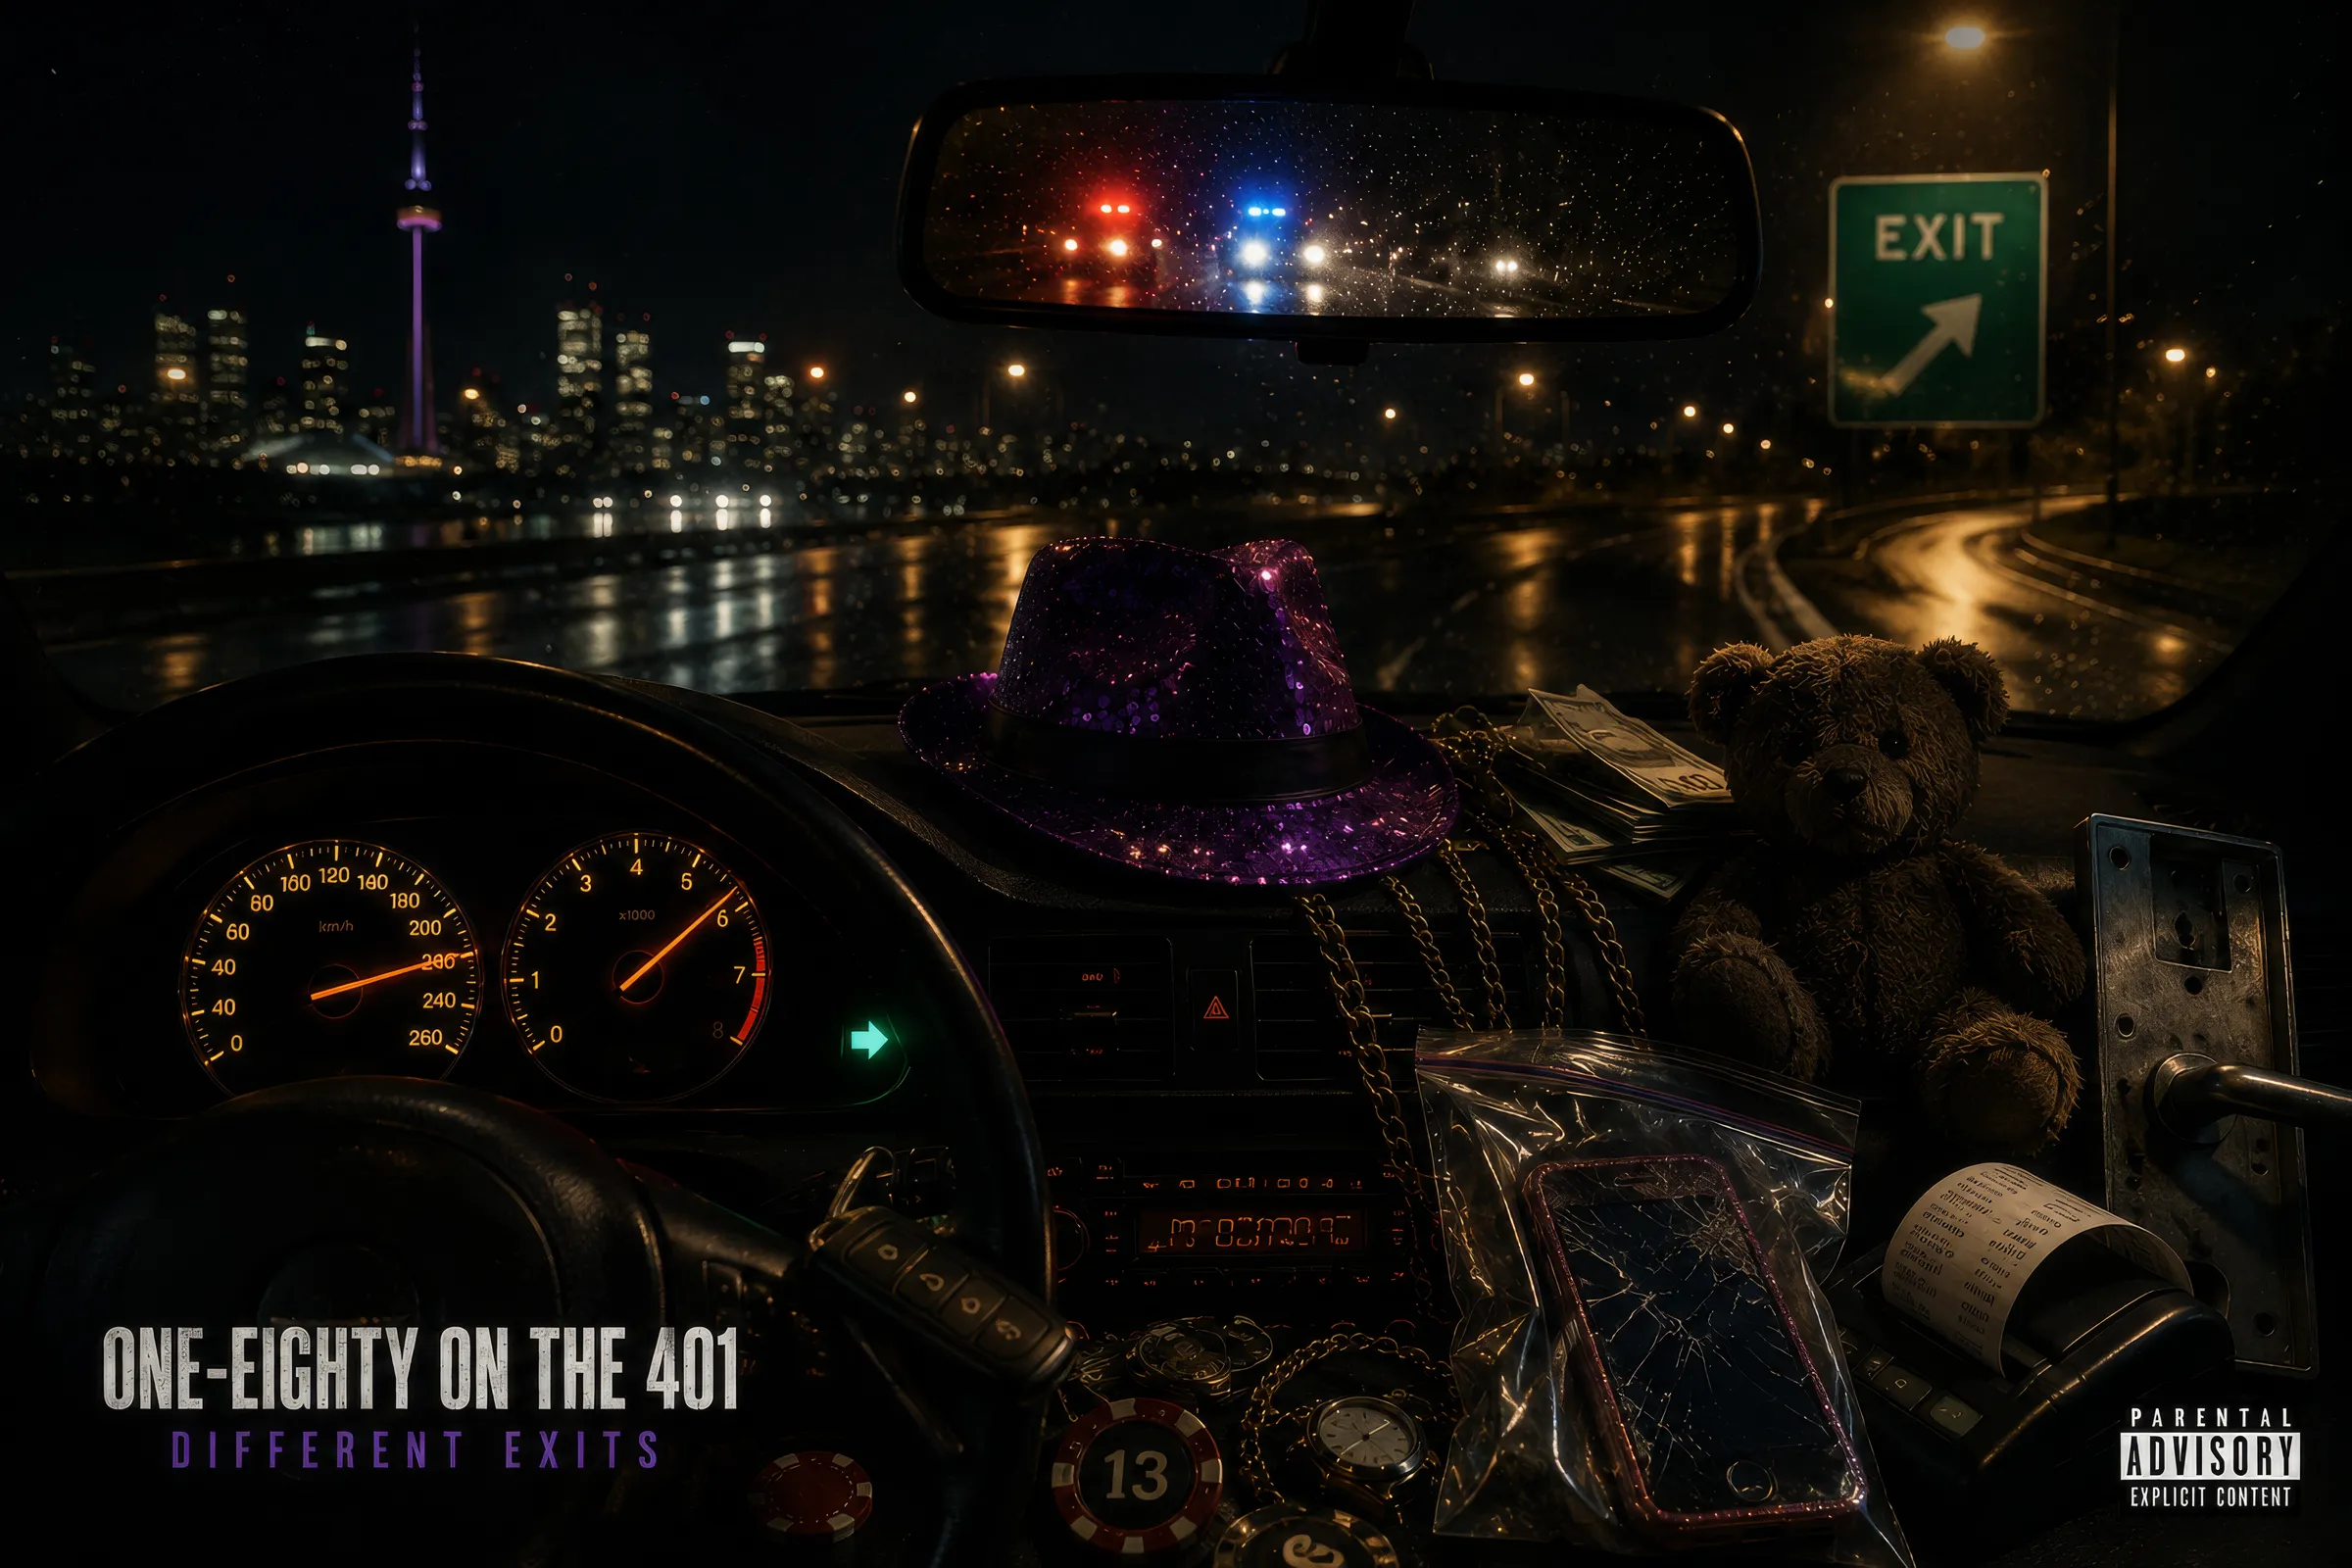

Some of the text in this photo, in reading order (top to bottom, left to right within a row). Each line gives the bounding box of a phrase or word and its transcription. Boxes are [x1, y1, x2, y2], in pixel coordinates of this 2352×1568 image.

[1876, 213, 2004, 261] EXIT
[319, 867, 349, 883] 120
[630, 858, 643, 875] 4
[580, 875, 591, 892] 3
[390, 893, 419, 908] 180
[545, 913, 556, 931] 2
[619, 910, 655, 919] x1000
[715, 909, 729, 927] 6
[226, 923, 249, 940] 60
[319, 920, 353, 932] km/h
[409, 919, 442, 937] 200
[212, 959, 235, 975] 40
[734, 966, 745, 983] 7
[532, 971, 538, 989] 1
[212, 999, 235, 1015] 40
[423, 993, 456, 1008] 240
[410, 1029, 442, 1046] 260
[551, 1026, 562, 1043] 0
[713, 1021, 723, 1038] 8
[231, 1035, 242, 1052] 0
[1105, 1450, 1167, 1499] 13
